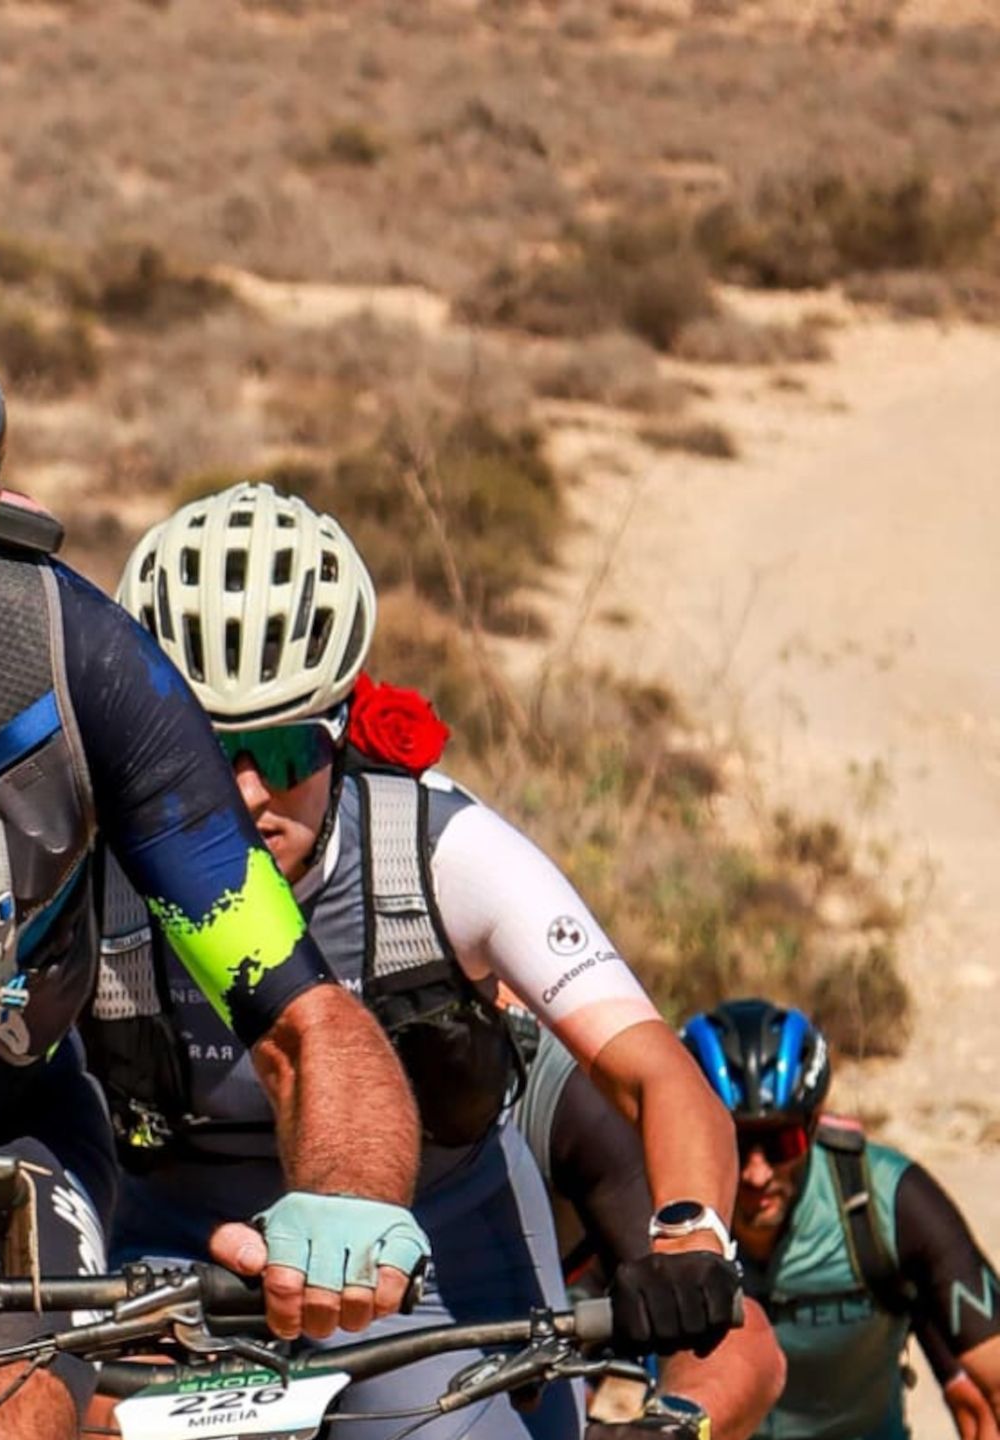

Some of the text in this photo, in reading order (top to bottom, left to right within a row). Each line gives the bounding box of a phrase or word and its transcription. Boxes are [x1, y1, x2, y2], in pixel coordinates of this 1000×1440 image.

[541, 957, 597, 1005] Caetano
[168, 1388, 288, 1417] 226
[187, 1409, 259, 1429] MIREIA
